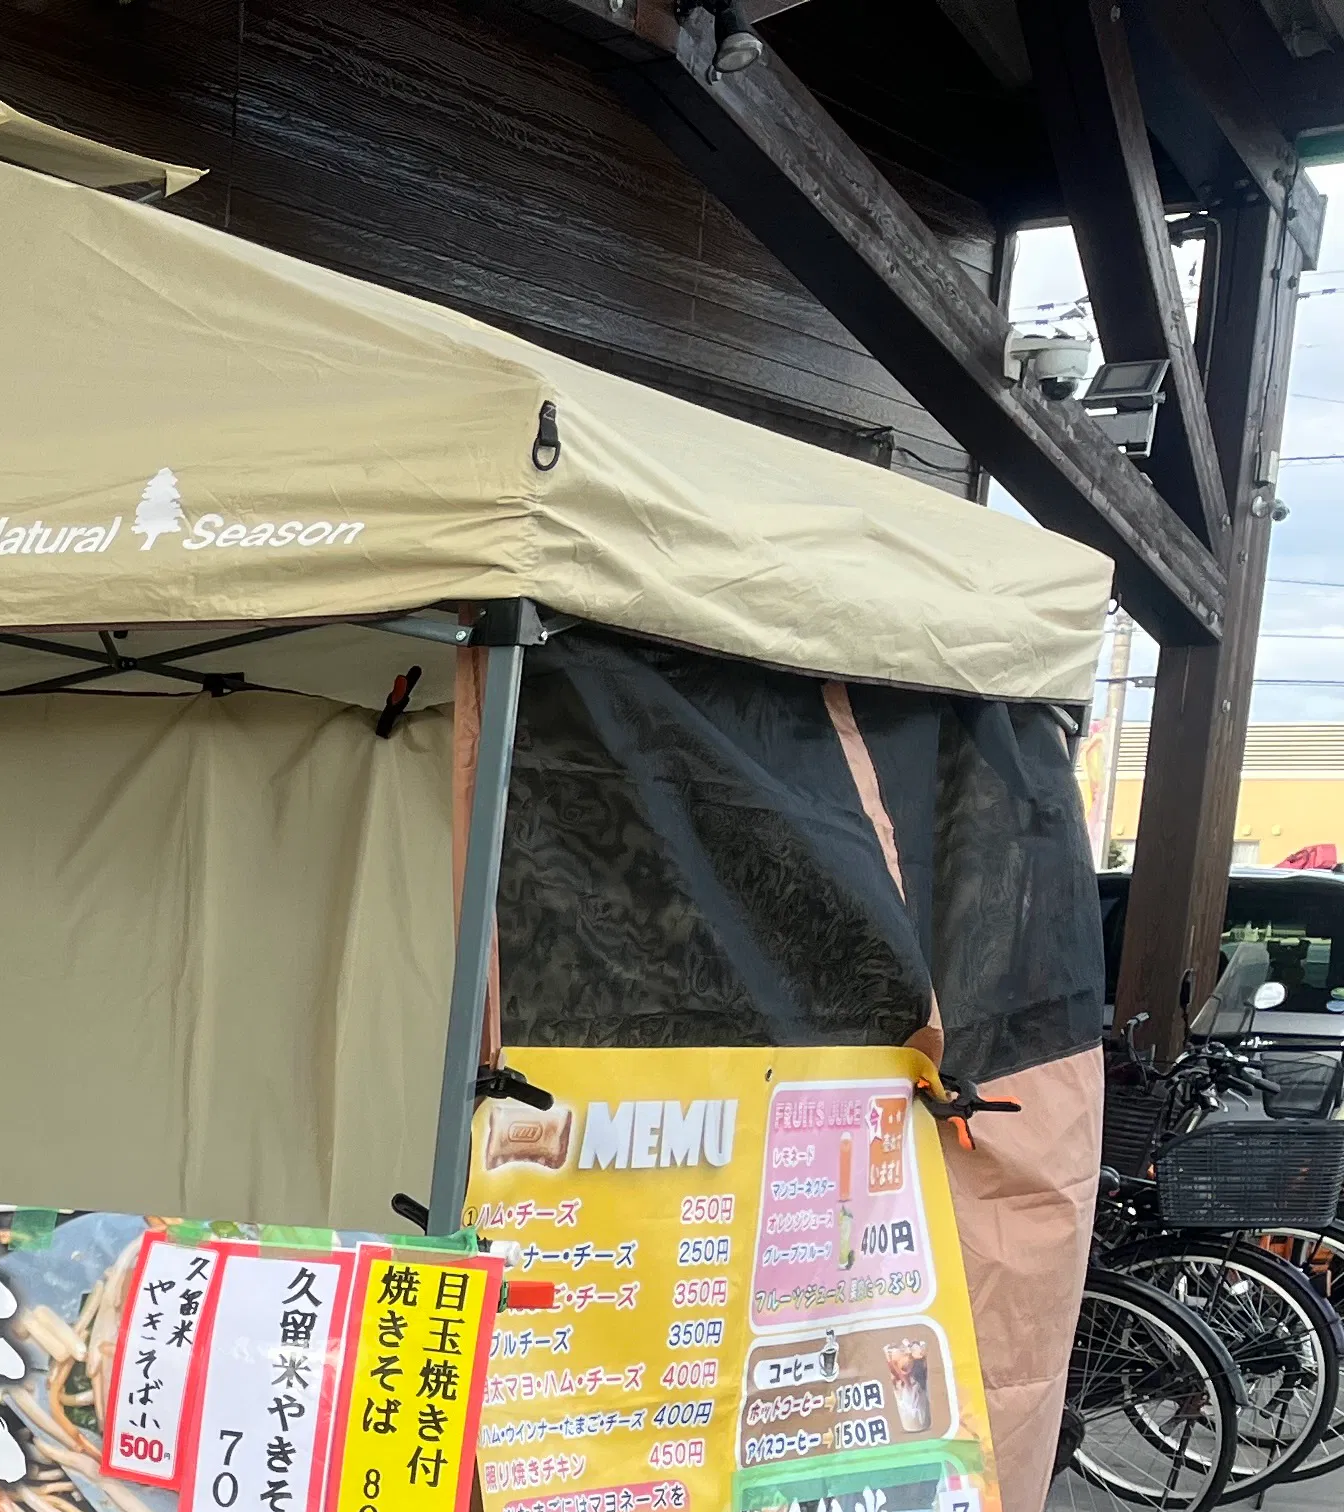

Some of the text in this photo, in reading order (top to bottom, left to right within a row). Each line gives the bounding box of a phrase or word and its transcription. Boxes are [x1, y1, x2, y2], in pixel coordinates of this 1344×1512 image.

[182, 514, 365, 551] Season
[775, 1099, 861, 1129] FRUITS JUICE
[578, 1100, 739, 1170] MEMU
[773, 1145, 815, 1168] レモネード
[772, 1177, 835, 1199] マンゴーネクター
[477, 1200, 581, 1228] ハム・チーズ
[681, 1196, 734, 1223] 250円
[678, 1238, 729, 1264] 250円
[861, 1220, 915, 1254] 400円
[165, 1257, 210, 1348] 久留米
[673, 1279, 727, 1306] 350円
[755, 1279, 845, 1313] フルーツジュース
[362, 1265, 421, 1435] 焼きそば
[668, 1321, 723, 1347] 350円
[407, 1272, 470, 1487] 目玉焼き付
[662, 1360, 717, 1387] 400円
[770, 1361, 814, 1384] コーヒー
[653, 1402, 712, 1428] 400円
[748, 1382, 883, 1424] ホットコーヒー 150円
[746, 1417, 889, 1463] アイスコーヒー 150円
[485, 1441, 704, 1492] 照り焼きチキン 450円
